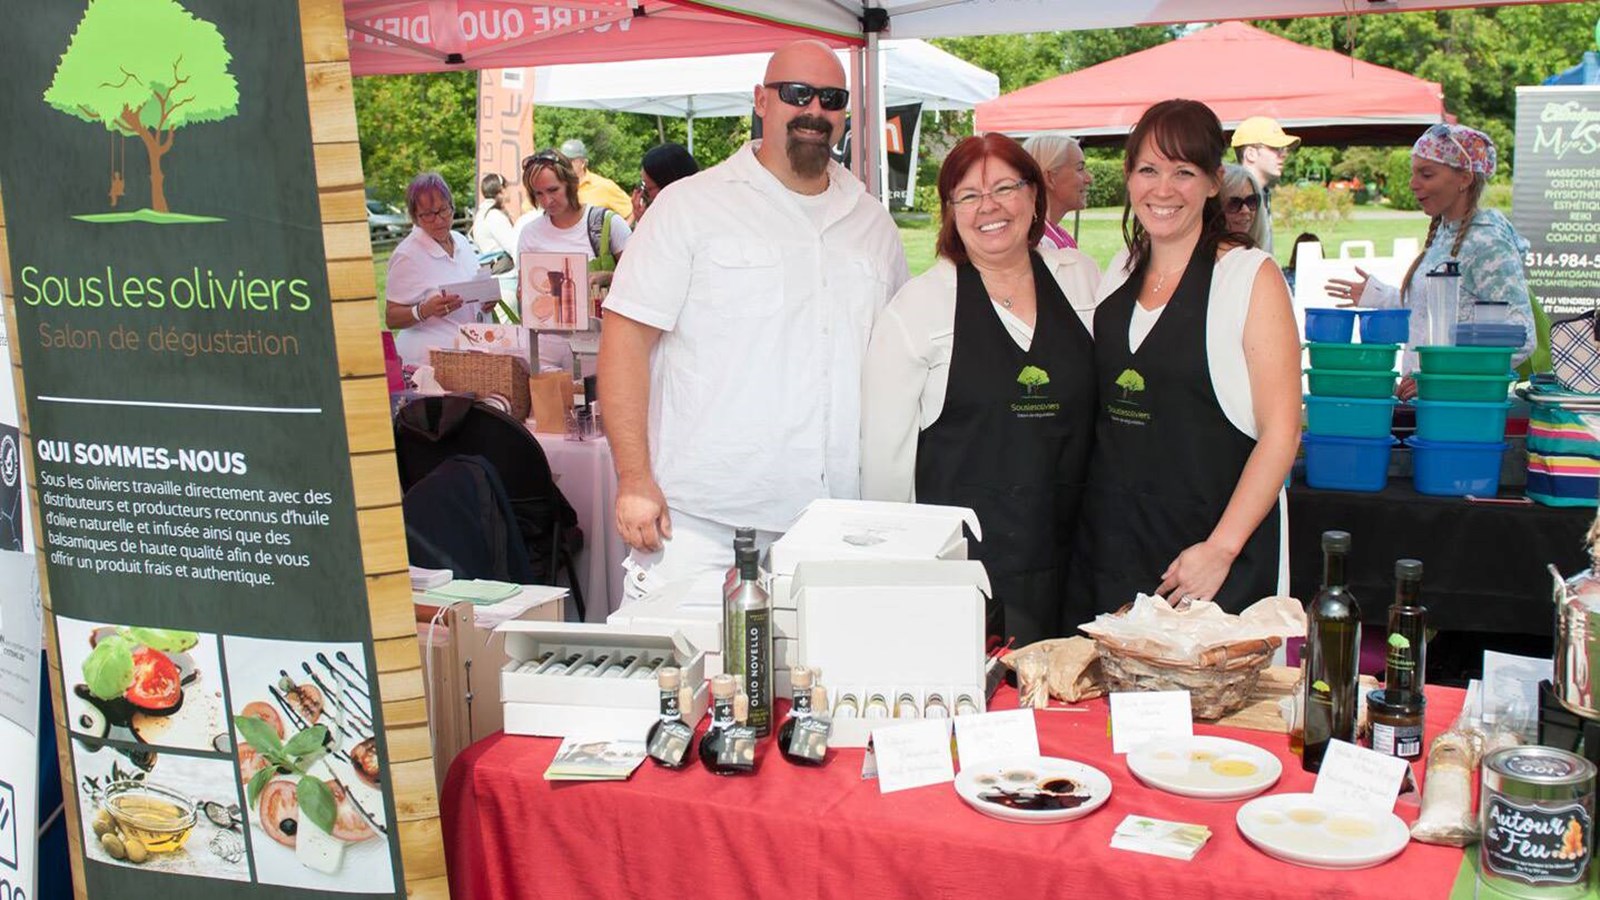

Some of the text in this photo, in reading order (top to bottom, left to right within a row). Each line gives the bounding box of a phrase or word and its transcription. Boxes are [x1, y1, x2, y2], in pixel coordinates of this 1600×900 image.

[1545, 232, 1598, 243] COACH DE
[38, 322, 299, 357] Salon de dégustation
[37, 438, 247, 475] QUI SOMMES-NOUS
[40, 470, 332, 505] Sous les oliviers travaille directement avec des
[43, 491, 114, 512] distributeurs
[116, 500, 131, 513] et
[132, 500, 212, 519] producteurs
[214, 507, 278, 524] reconnus
[47, 529, 310, 567] balsamiques de haute qualité afin de vous
[79, 517, 134, 533] naturelle
[136, 521, 151, 534] et
[152, 520, 200, 538] infusée
[202, 524, 233, 541] ainsi
[235, 530, 262, 546] que
[264, 529, 291, 545] des
[50, 550, 275, 588] offrir un produit frais et authentique.
[750, 627, 759, 677] NOVELLO
[750, 680, 759, 707] OLIO
[1489, 804, 1565, 836] Autour
[1499, 826, 1551, 859] Feu
